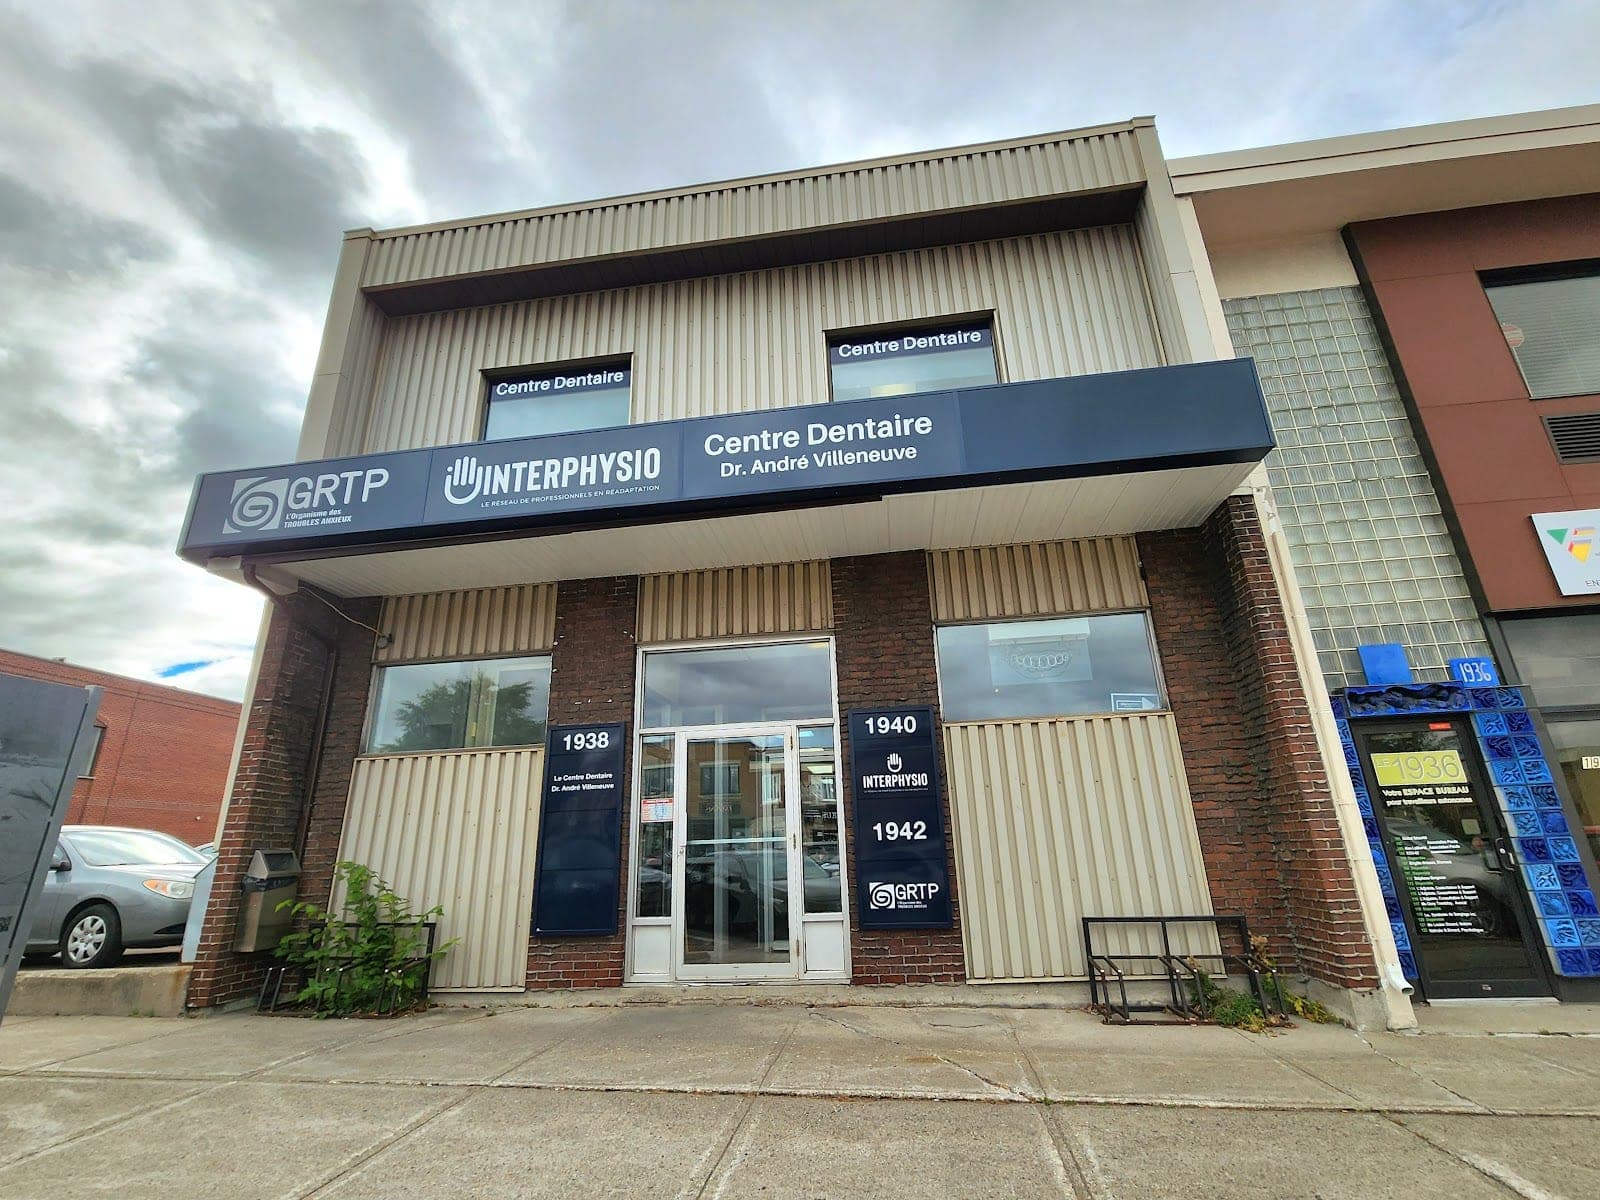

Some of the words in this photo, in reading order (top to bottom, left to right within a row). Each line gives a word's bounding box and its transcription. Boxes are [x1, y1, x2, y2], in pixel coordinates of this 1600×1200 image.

[838, 341, 899, 357] Centre
[903, 330, 982, 350] Dentaire
[496, 380, 550, 395] Centre
[554, 371, 624, 389] Dentaire
[704, 429, 800, 456] Centre
[807, 414, 933, 446] Dentaire
[482, 447, 661, 496] INTERPHYSIO
[720, 462, 747, 478] Dr.
[751, 455, 809, 475] André
[813, 446, 917, 467] Villeneuve
[287, 468, 389, 510] GRTP
[531, 491, 592, 503] PROFESSIONNELS
[320, 516, 352, 525] ANXIEUX
[1459, 662, 1492, 682] 1936
[865, 715, 917, 734] 1940
[563, 731, 609, 751] 1938
[585, 772, 613, 780] Dentaire
[1391, 754, 1460, 780] 1936
[582, 783, 614, 791] Villeneuve
[862, 773, 928, 789] INTERPHYSIO
[872, 820, 927, 841] 1942
[895, 882, 939, 900] GRTP
